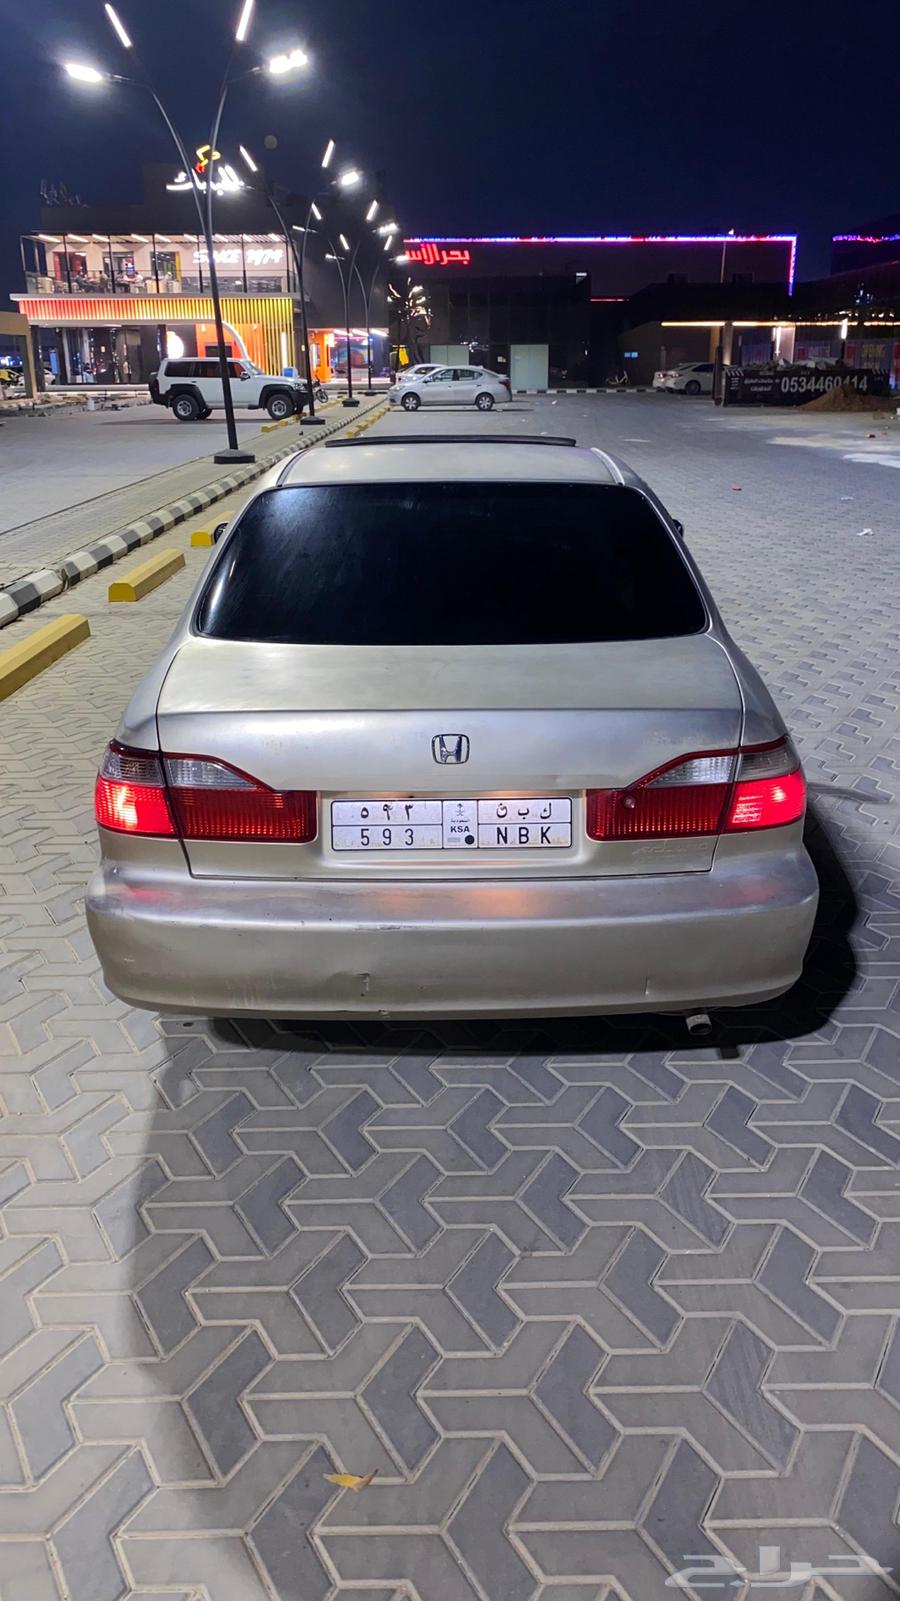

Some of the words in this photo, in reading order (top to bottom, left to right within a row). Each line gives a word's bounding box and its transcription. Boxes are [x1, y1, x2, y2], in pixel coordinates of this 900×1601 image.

[192, 248, 242, 264] SNCE
[440, 250, 470, 265] بحر
[450, 825, 470, 833] KSA
